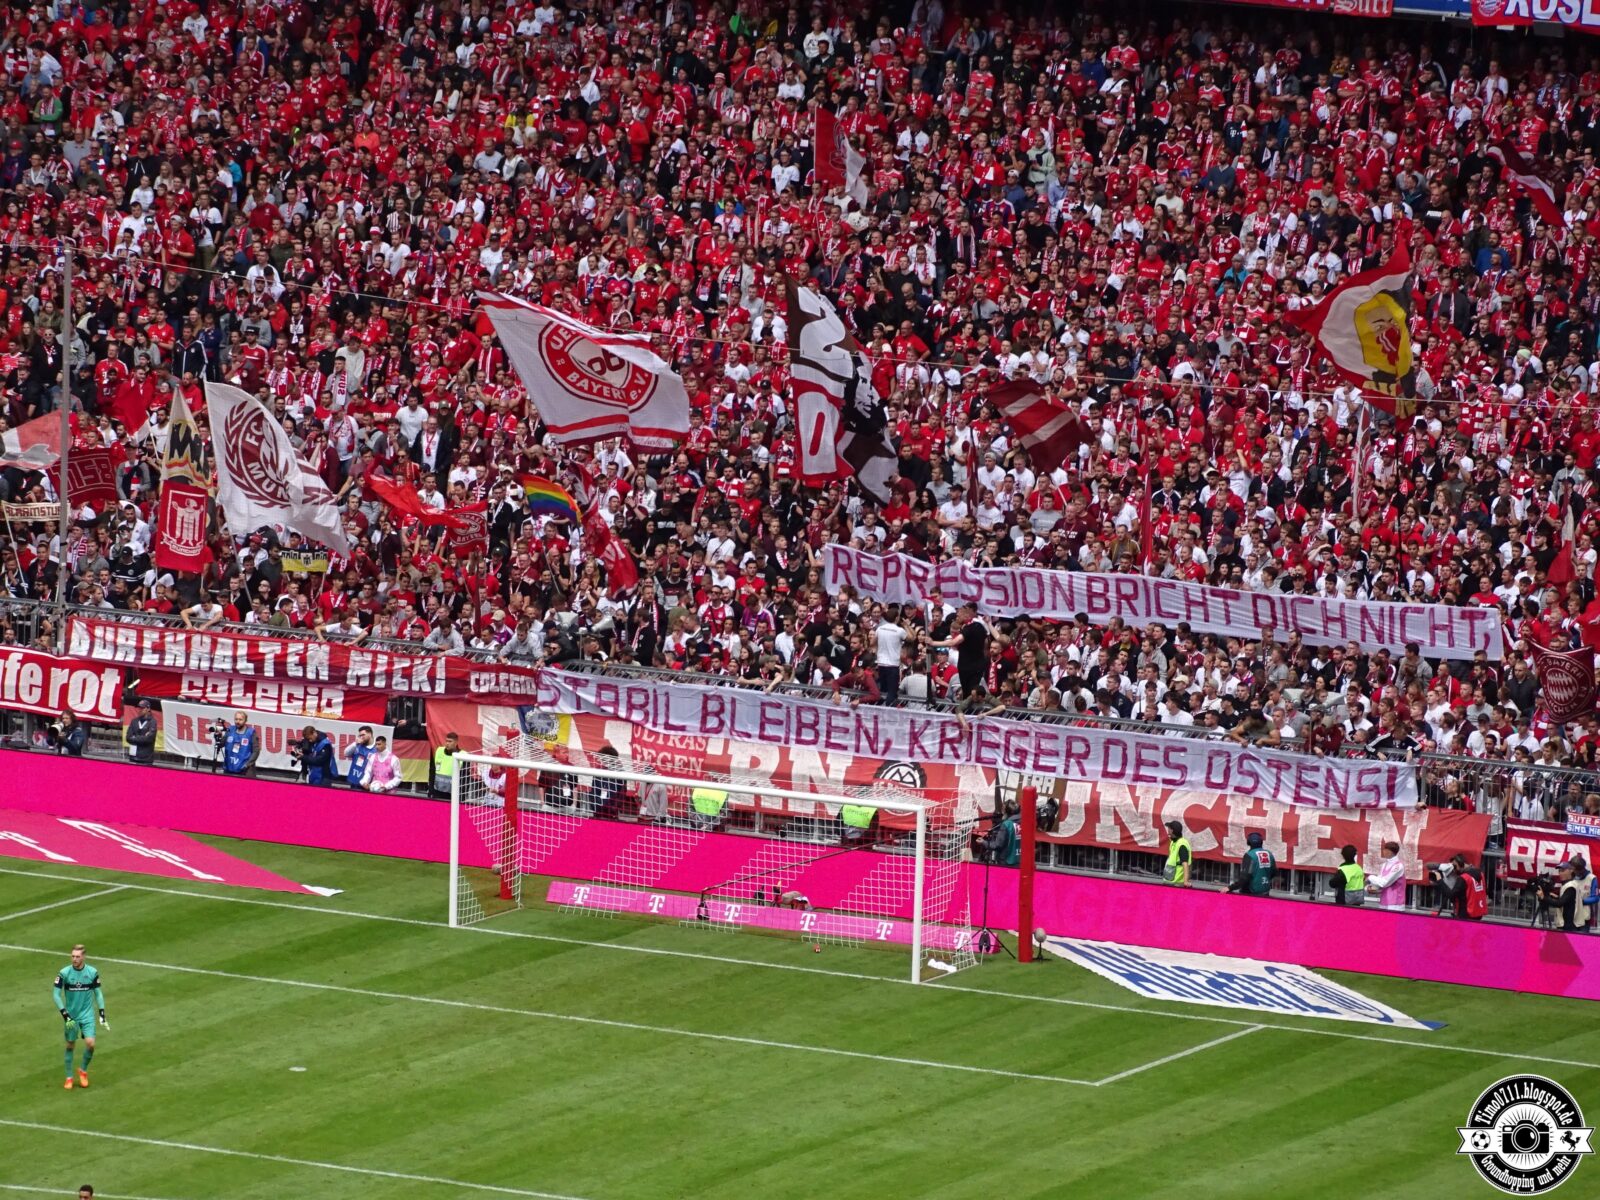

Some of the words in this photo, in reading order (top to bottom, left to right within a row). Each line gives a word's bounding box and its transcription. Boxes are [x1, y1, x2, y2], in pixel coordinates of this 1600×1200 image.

[832, 547, 1075, 612] REPRESSION
[1086, 575, 1240, 625] BRICHT
[1251, 593, 1347, 639] DICH
[1360, 605, 1491, 650] NICHT,
[69, 619, 330, 681] DURCHHALTEN
[0, 652, 42, 705] fe
[48, 666, 120, 717] rot
[181, 673, 344, 717] COLEGIO
[230, 757, 240, 765] TV
[537, 670, 687, 732] STABIL
[700, 693, 893, 757] BLEIBEN,
[908, 718, 1091, 777] KRIEGER
[1101, 738, 1188, 786] DES
[1205, 749, 1398, 810] OSTENS!
[352, 768, 362, 779] TV
[1048, 938, 1343, 1016] Allianz
